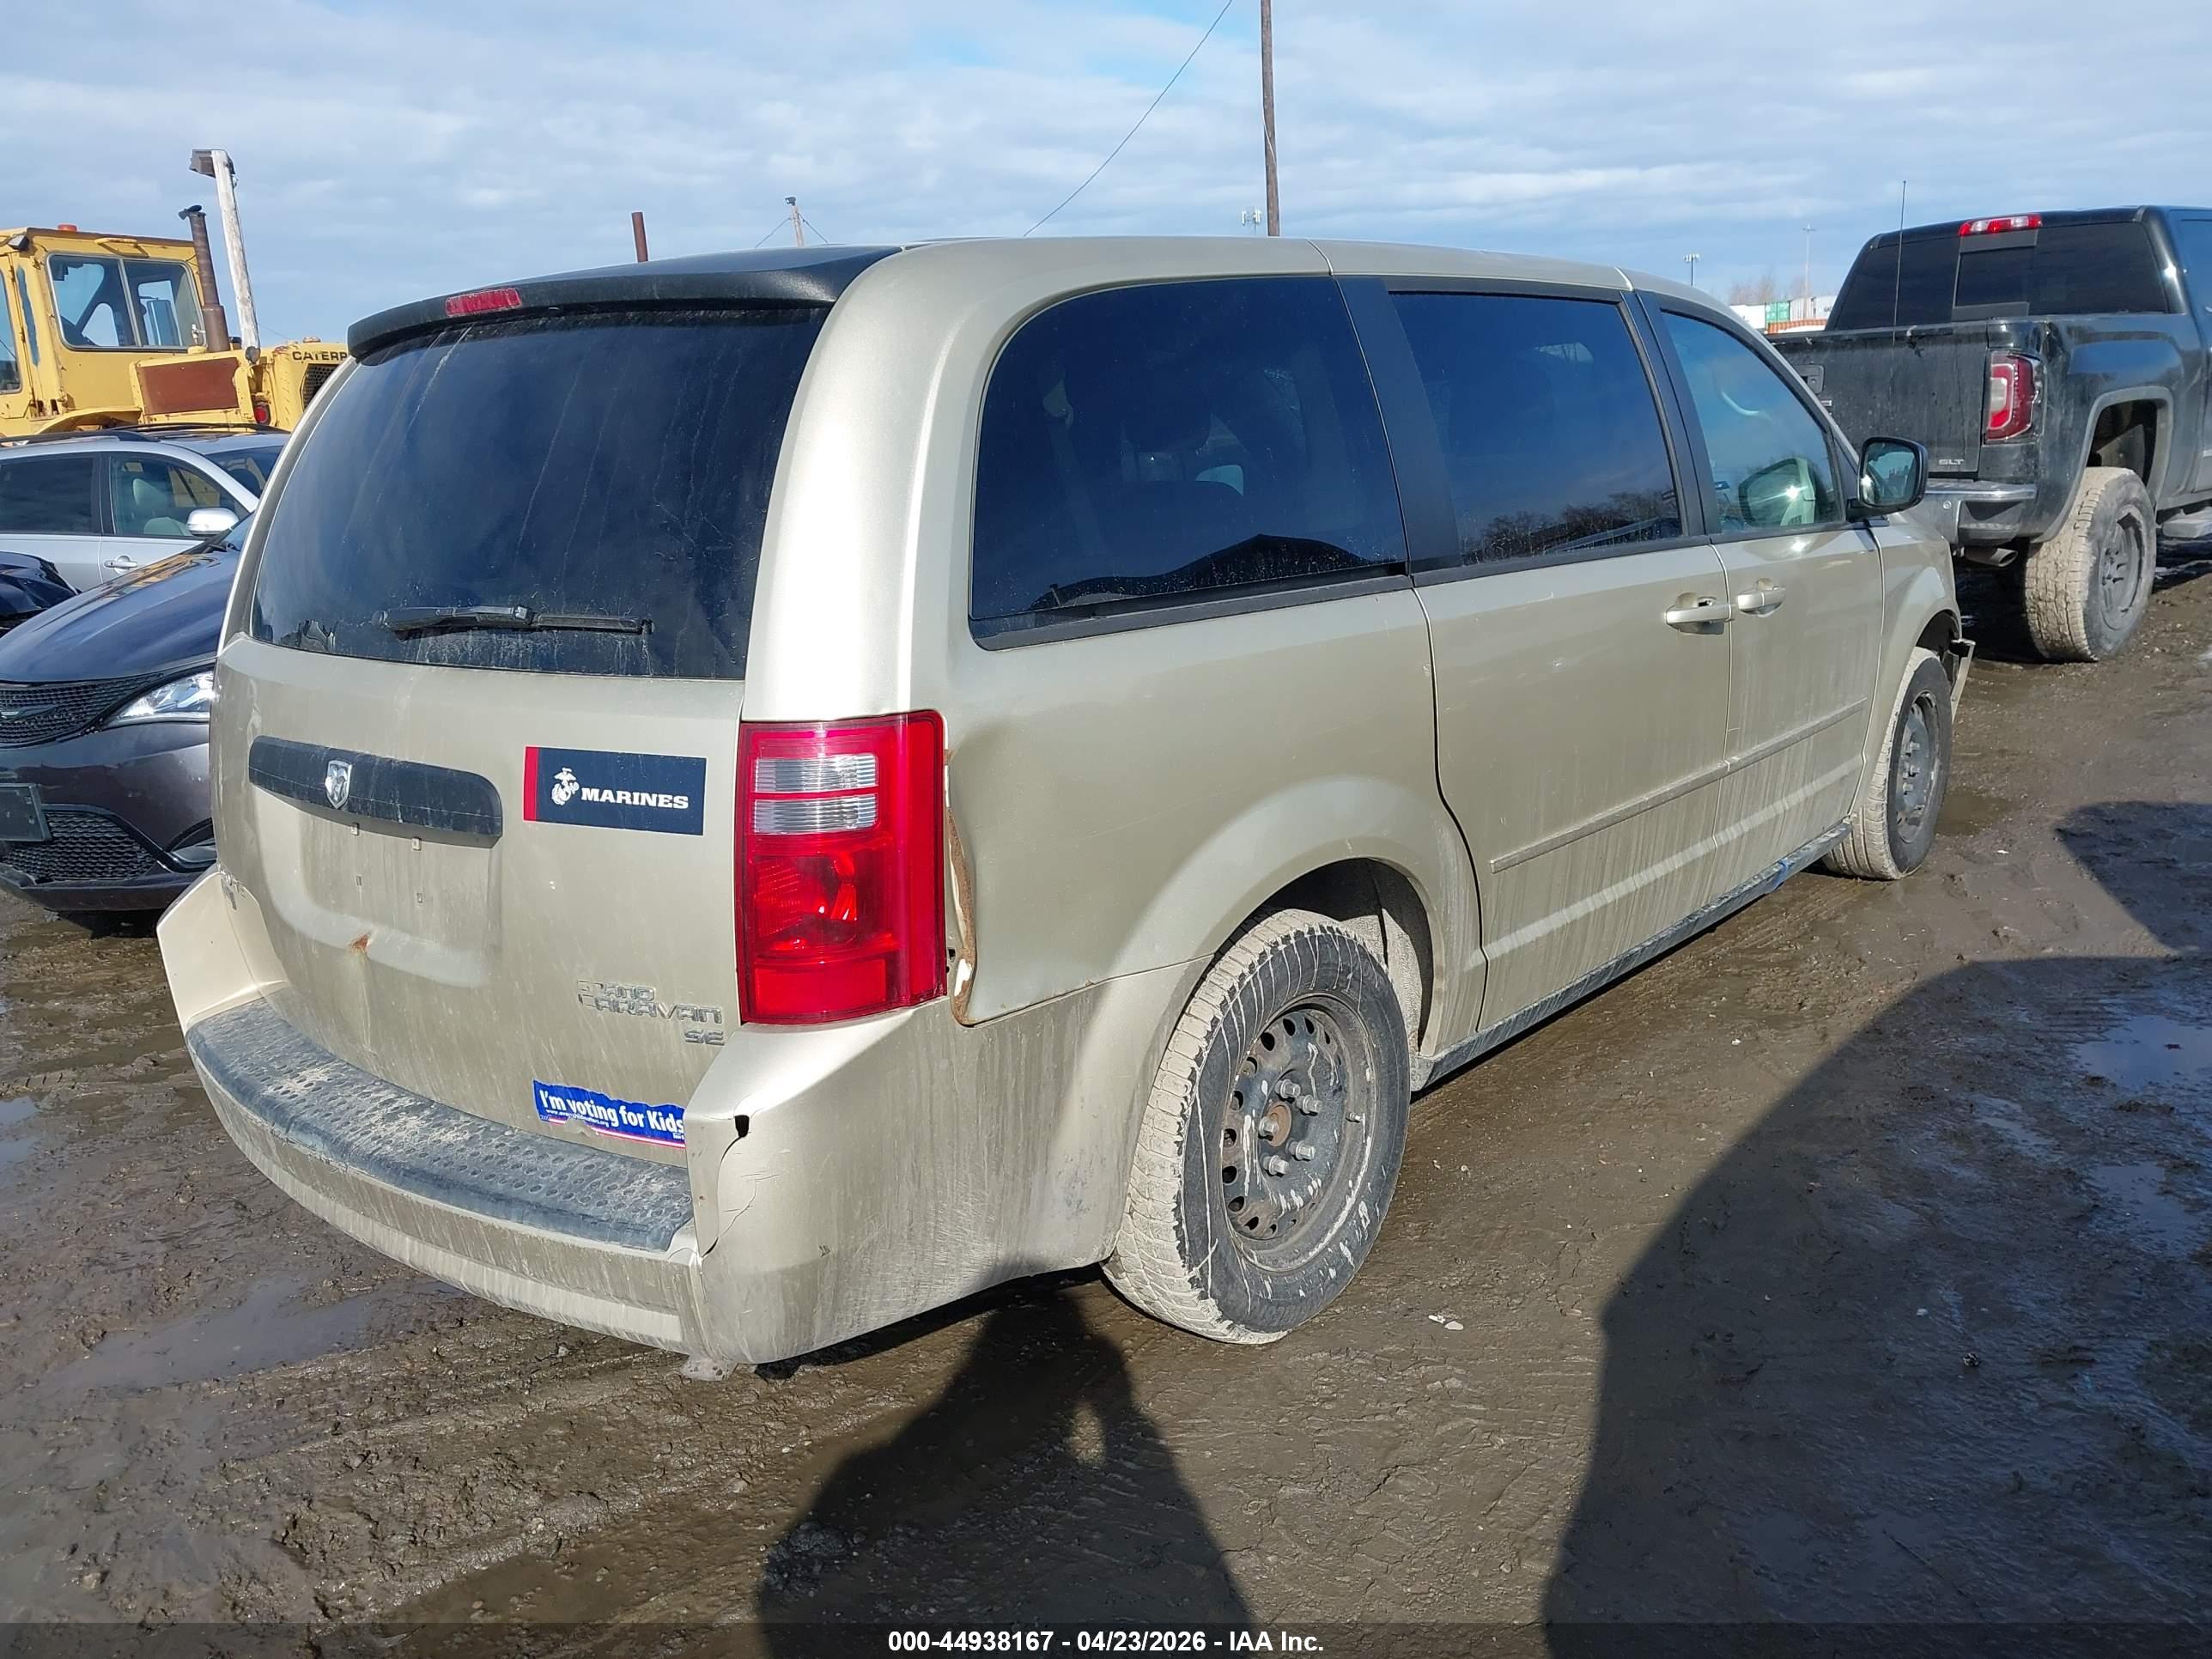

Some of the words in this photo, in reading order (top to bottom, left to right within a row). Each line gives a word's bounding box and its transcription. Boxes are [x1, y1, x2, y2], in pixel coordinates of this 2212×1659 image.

[580, 787, 689, 809] MARINES
[577, 993, 723, 1024] CARAVAN
[684, 1030, 726, 1046] SE
[539, 1090, 568, 1112] I'm
[566, 1099, 620, 1127] voting
[618, 1105, 646, 1128] for
[646, 1110, 684, 1134] Kids
